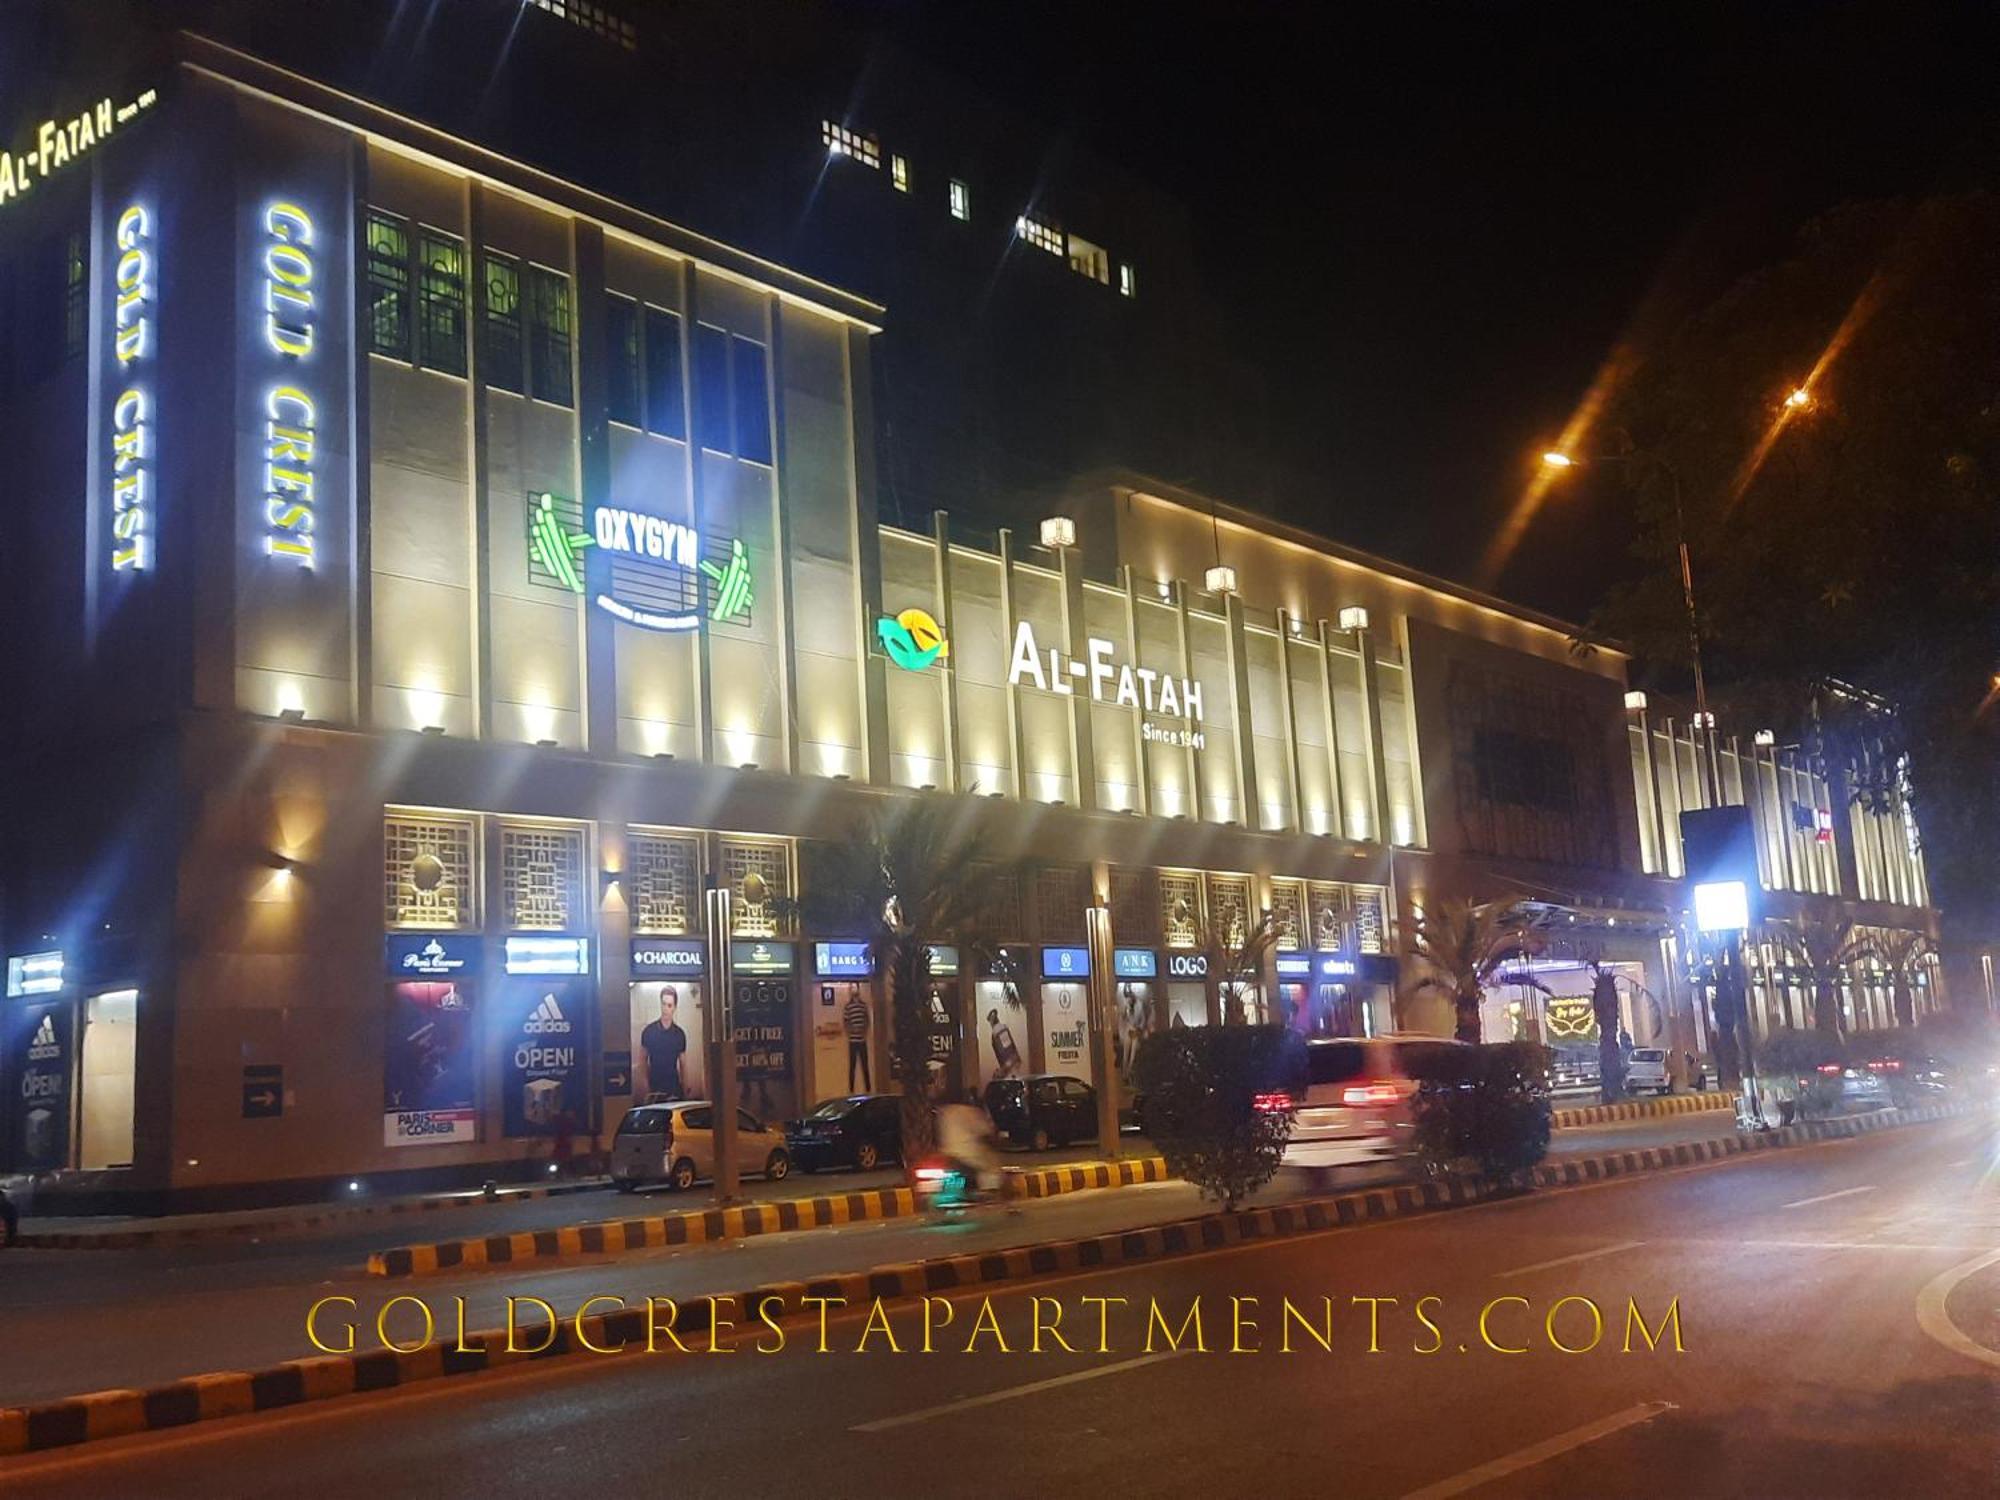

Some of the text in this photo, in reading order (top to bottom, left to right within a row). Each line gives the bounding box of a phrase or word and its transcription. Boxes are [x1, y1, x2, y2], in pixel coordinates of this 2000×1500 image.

[113, 206, 148, 571] GOLD CREST
[266, 203, 315, 570] GOLD CREST
[595, 507, 698, 569] OXYGYM
[1008, 621, 1204, 721] AL-FATAH
[1143, 722, 1205, 750] Since 1941
[643, 951, 703, 965] CHARCOAL
[1169, 956, 1208, 975] LOGO
[739, 986, 788, 1003] OGO
[523, 1020, 571, 1034] adidas
[1051, 1031, 1085, 1048] SUMMER
[514, 1047, 575, 1069] OPEN!
[398, 1113, 431, 1125] PARIS
[407, 1122, 454, 1136] CORNER
